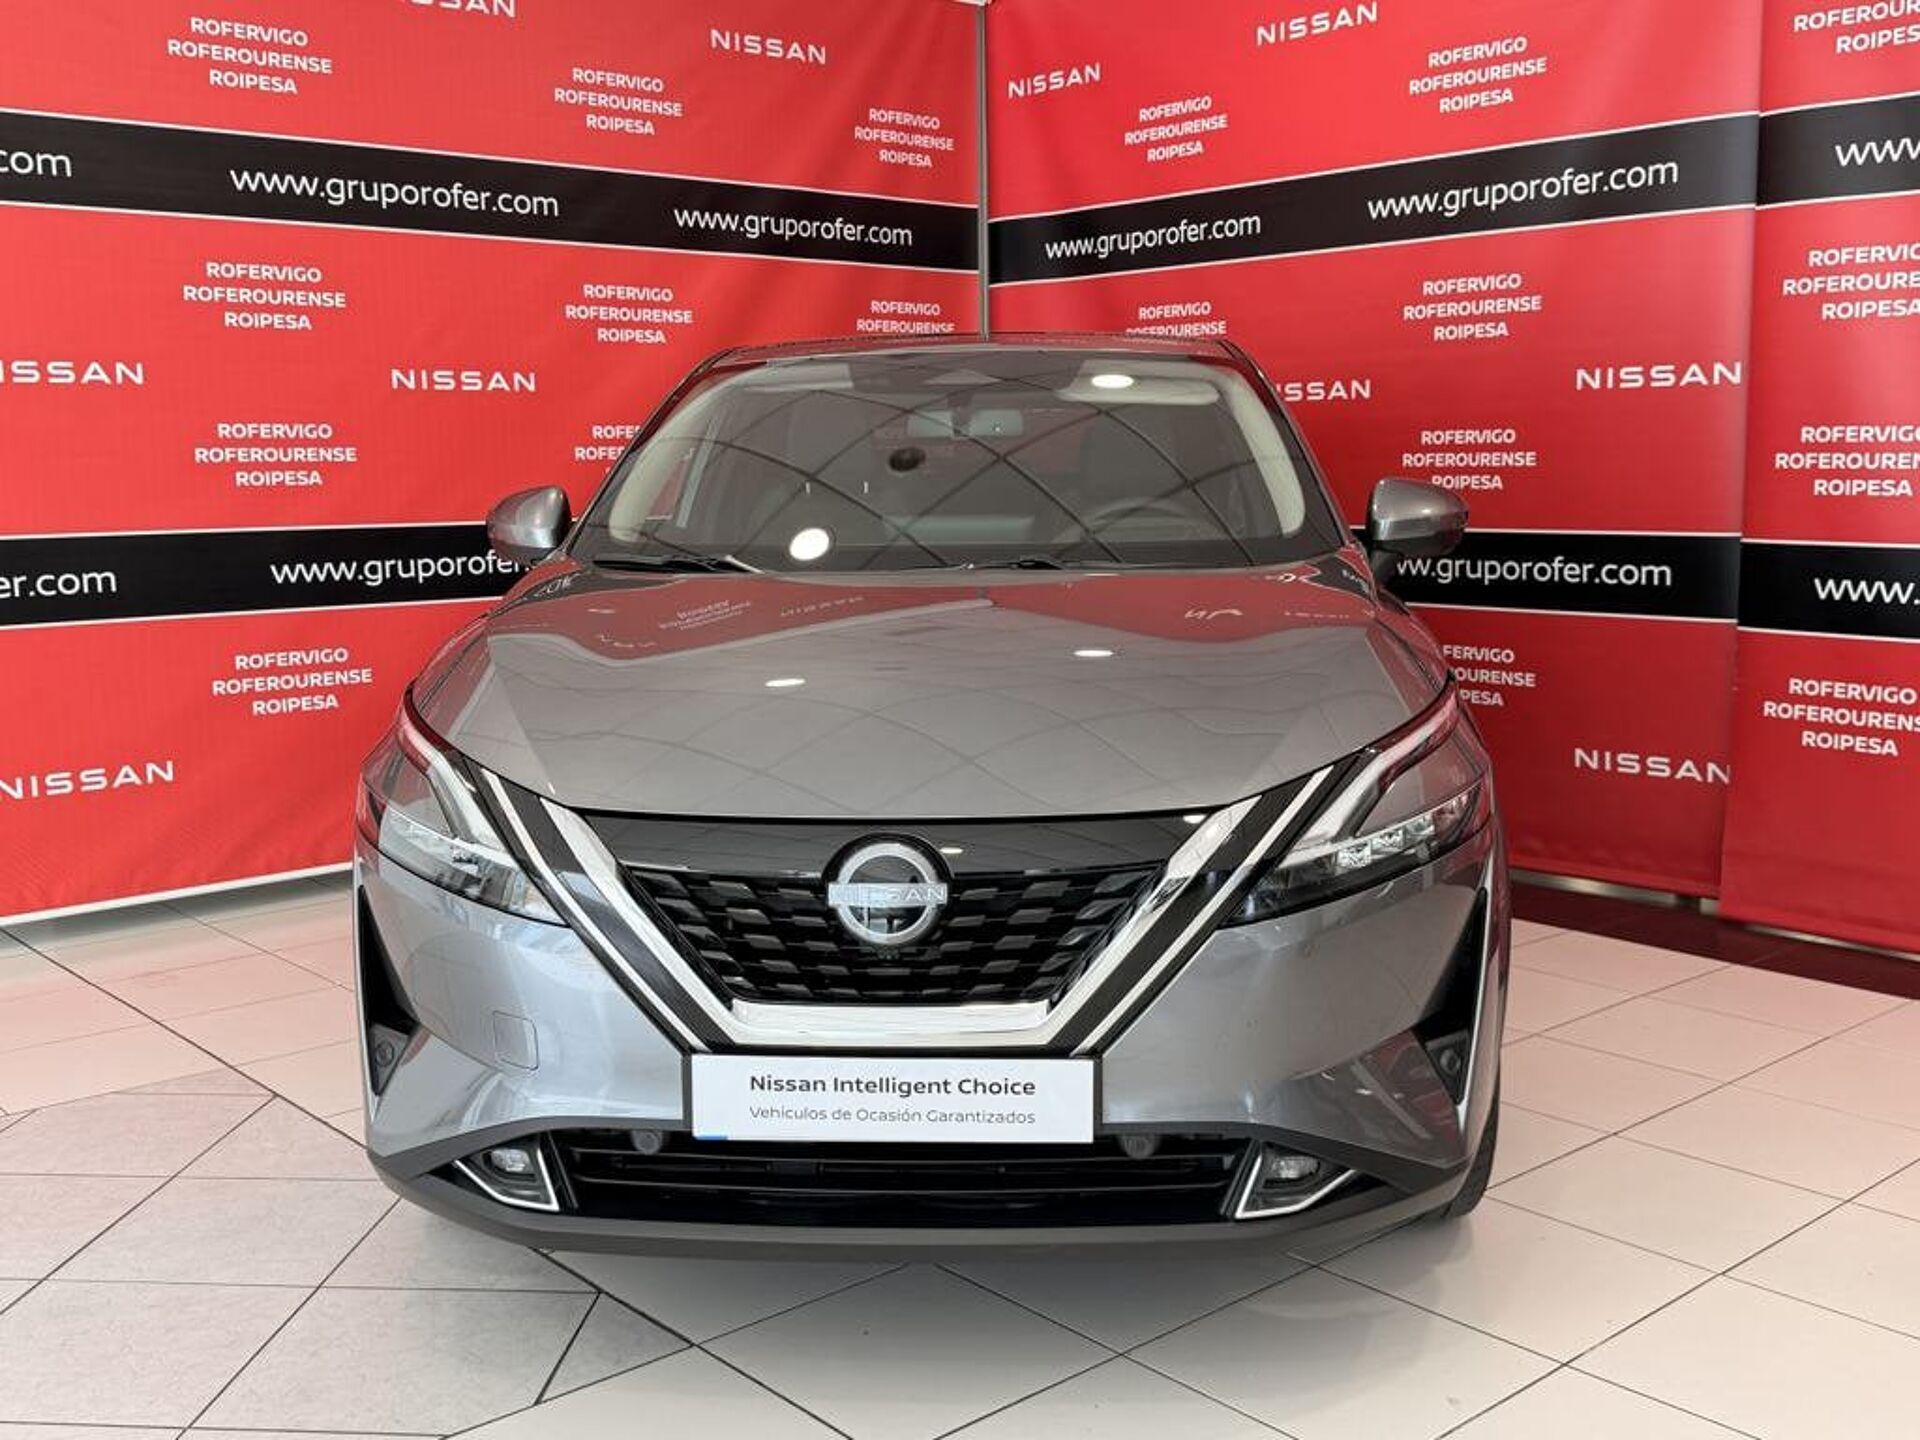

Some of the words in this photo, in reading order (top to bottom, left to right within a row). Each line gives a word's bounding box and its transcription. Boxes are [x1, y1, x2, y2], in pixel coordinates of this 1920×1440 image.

[191, 17, 308, 47] ROFERVIGO
[1257, 2, 1377, 45] NISSAN
[168, 40, 332, 74] ROFEROURENSE
[711, 29, 825, 64] NISSAN
[1428, 36, 1528, 69] ROFERVIGO
[209, 68, 298, 94] ROIPESA
[571, 68, 664, 93] ROFERVIGO
[1009, 64, 1100, 98] NISSAN
[1409, 57, 1547, 94] ROFEROURENSE
[554, 88, 683, 117] ROFEROURENSE
[1138, 96, 1212, 122] ROFERVIGO
[1439, 87, 1513, 113] ROIPESA
[586, 114, 655, 135] ROIPESA
[869, 108, 941, 130] ROFERVIGO
[1124, 114, 1228, 146] ROFEROURENSE
[854, 126, 954, 151] ROFEROURENSE
[879, 149, 933, 168] ROIPESA
[1147, 140, 1203, 162] ROIPESA
[230, 168, 559, 217] www.gruporofer.com
[1367, 159, 1678, 221] www.gruporofer.com
[674, 208, 913, 247] www.gruporofer.com
[1045, 212, 1261, 260] www.gruporofer.com
[207, 262, 321, 282] ROFERVIGO
[184, 280, 345, 307] ROFEROURENSE
[583, 284, 673, 302] ROFERVIGO
[1423, 274, 1521, 295] ROFERVIGO
[566, 305, 692, 323] ROFEROURENSE
[871, 300, 940, 315] ROFERVIGO
[1139, 302, 1211, 319] ROFERVIGO
[1404, 292, 1541, 319] ROFEROURENSE
[225, 312, 311, 329] ROIPESA
[1434, 322, 1508, 340] ROIPESA
[598, 328, 666, 343] ROIPESA
[392, 369, 535, 391] NISSAN
[1577, 362, 1741, 389] NISSAN
[218, 423, 332, 438] ROFERVIGO
[592, 426, 640, 439] ROFE
[1422, 429, 1515, 444] ROFERVIGO
[195, 448, 356, 462] ROFEROURENSE
[1403, 452, 1536, 467] ROFEROURENSE
[236, 471, 322, 486] ROIPESA
[1815, 480, 1912, 496] ROIPESA
[235, 648, 348, 670] ROFERVIGO
[213, 667, 372, 696] ROFEROURENSE
[1450, 667, 1535, 687] OURENSE
[1788, 677, 1918, 706] ROFERVIGO
[253, 694, 338, 715] ROIPESA
[1801, 730, 1899, 757] ROIPESA
[1575, 749, 1729, 783] NISSAN
[750, 1076, 826, 1093] Nissan
[833, 1076, 951, 1099] Intelligent
[958, 1078, 1036, 1096] Choice
[832, 1108, 851, 1121] de
[856, 1106, 922, 1123] Ocasión
[926, 1109, 1036, 1124] Garantizados
